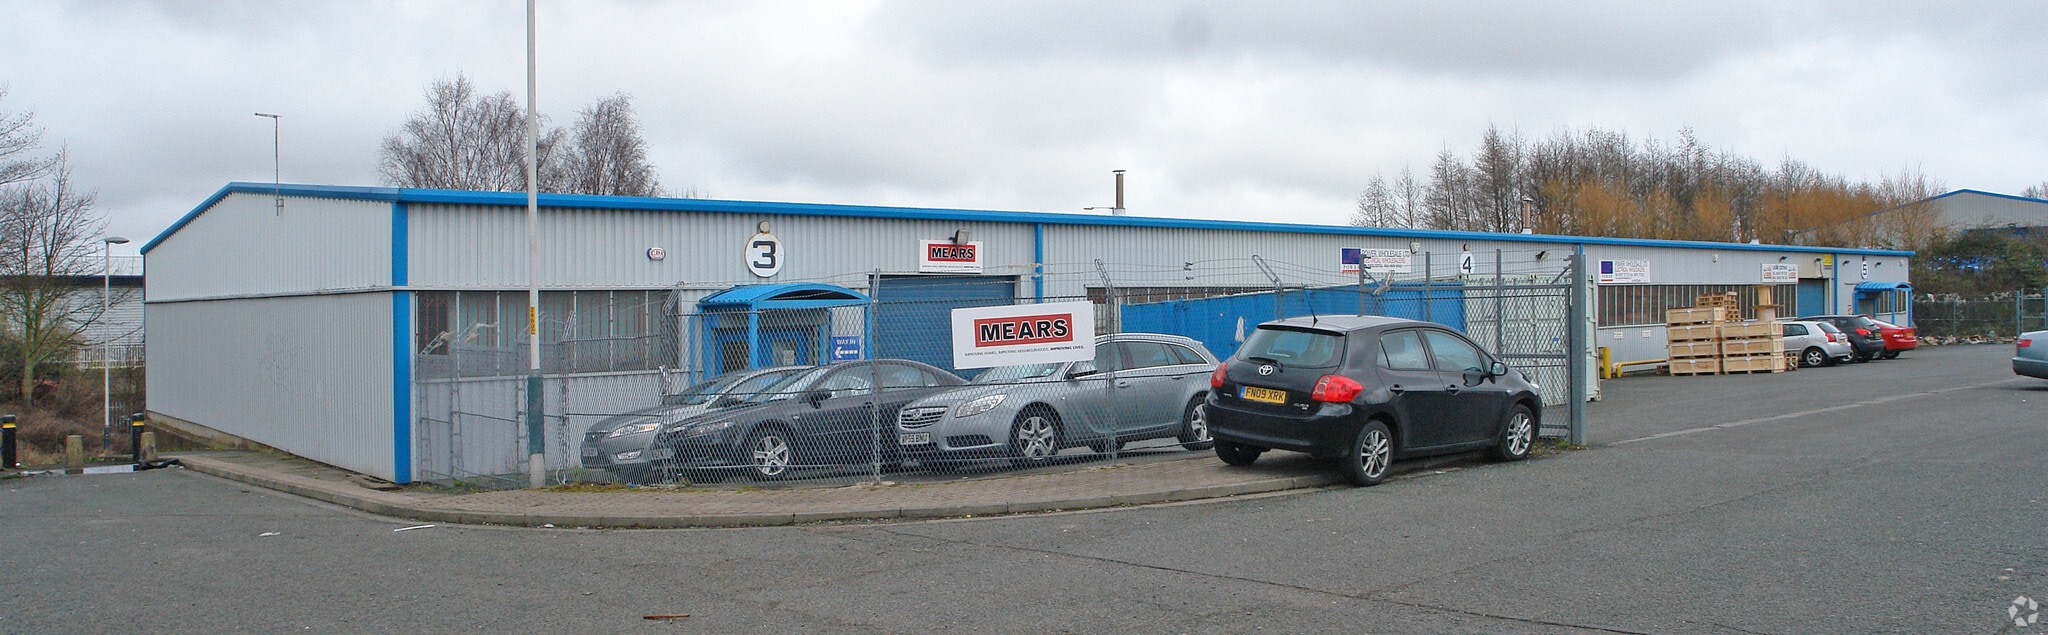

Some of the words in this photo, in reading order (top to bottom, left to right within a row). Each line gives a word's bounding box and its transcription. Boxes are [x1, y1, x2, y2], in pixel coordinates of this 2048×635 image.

[752, 240, 776, 269] 3
[931, 247, 974, 259] MEARS
[1462, 255, 1472, 274] 4
[1862, 263, 1868, 276] 5
[980, 319, 1069, 342] MEARS
[1245, 387, 1267, 399] FN09
[1267, 390, 1285, 401] XRK
